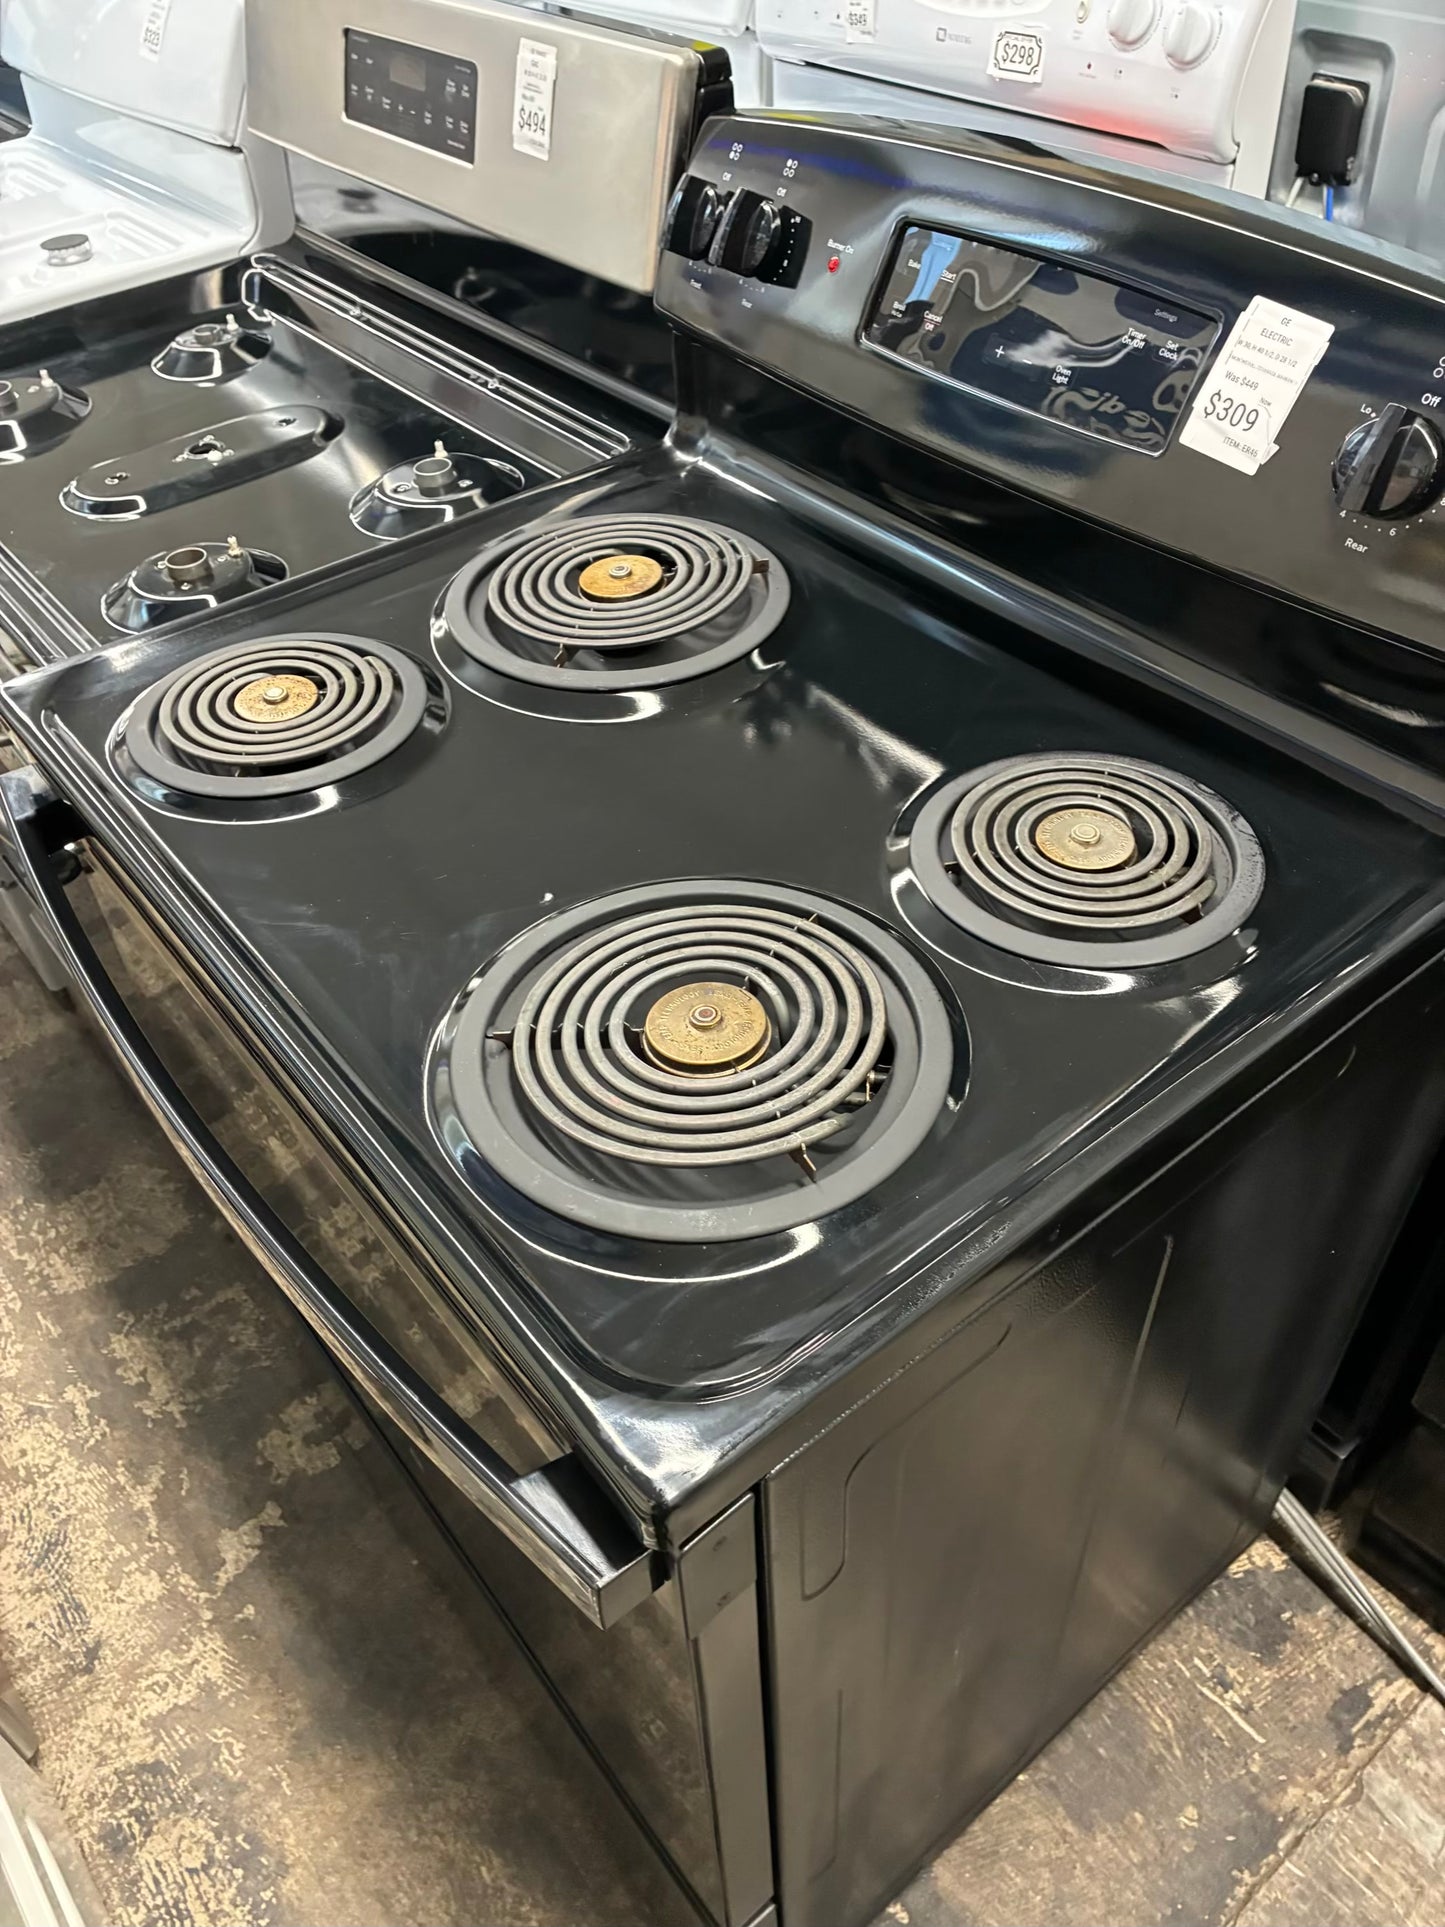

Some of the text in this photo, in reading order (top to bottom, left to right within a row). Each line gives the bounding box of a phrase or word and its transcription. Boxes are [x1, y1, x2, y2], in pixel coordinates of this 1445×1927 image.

[1001, 40, 1035, 66] $298
[518, 104, 546, 136] $494
[827, 238, 846, 252] Burner
[941, 269, 957, 280] Start
[923, 310, 943, 323] Cancel
[1154, 308, 1179, 323] Settings
[924, 322, 935, 332] Off
[1280, 317, 1293, 328] GE
[1126, 327, 1148, 340] Timer
[1260, 328, 1294, 347] ELECTRIC
[1121, 335, 1146, 350] On/Off
[1165, 340, 1180, 351] Set
[1158, 348, 1178, 361] Clock
[1055, 364, 1072, 377] Oven
[1051, 372, 1070, 385] Light
[1225, 370, 1241, 384] Was
[1239, 375, 1260, 391] $449
[1421, 393, 1443, 408] Off
[1203, 388, 1260, 432] $309
[1360, 403, 1373, 415] Lo
[1339, 509, 1347, 519] 4
[1389, 527, 1397, 537] 6
[1344, 537, 1369, 554] Rear
